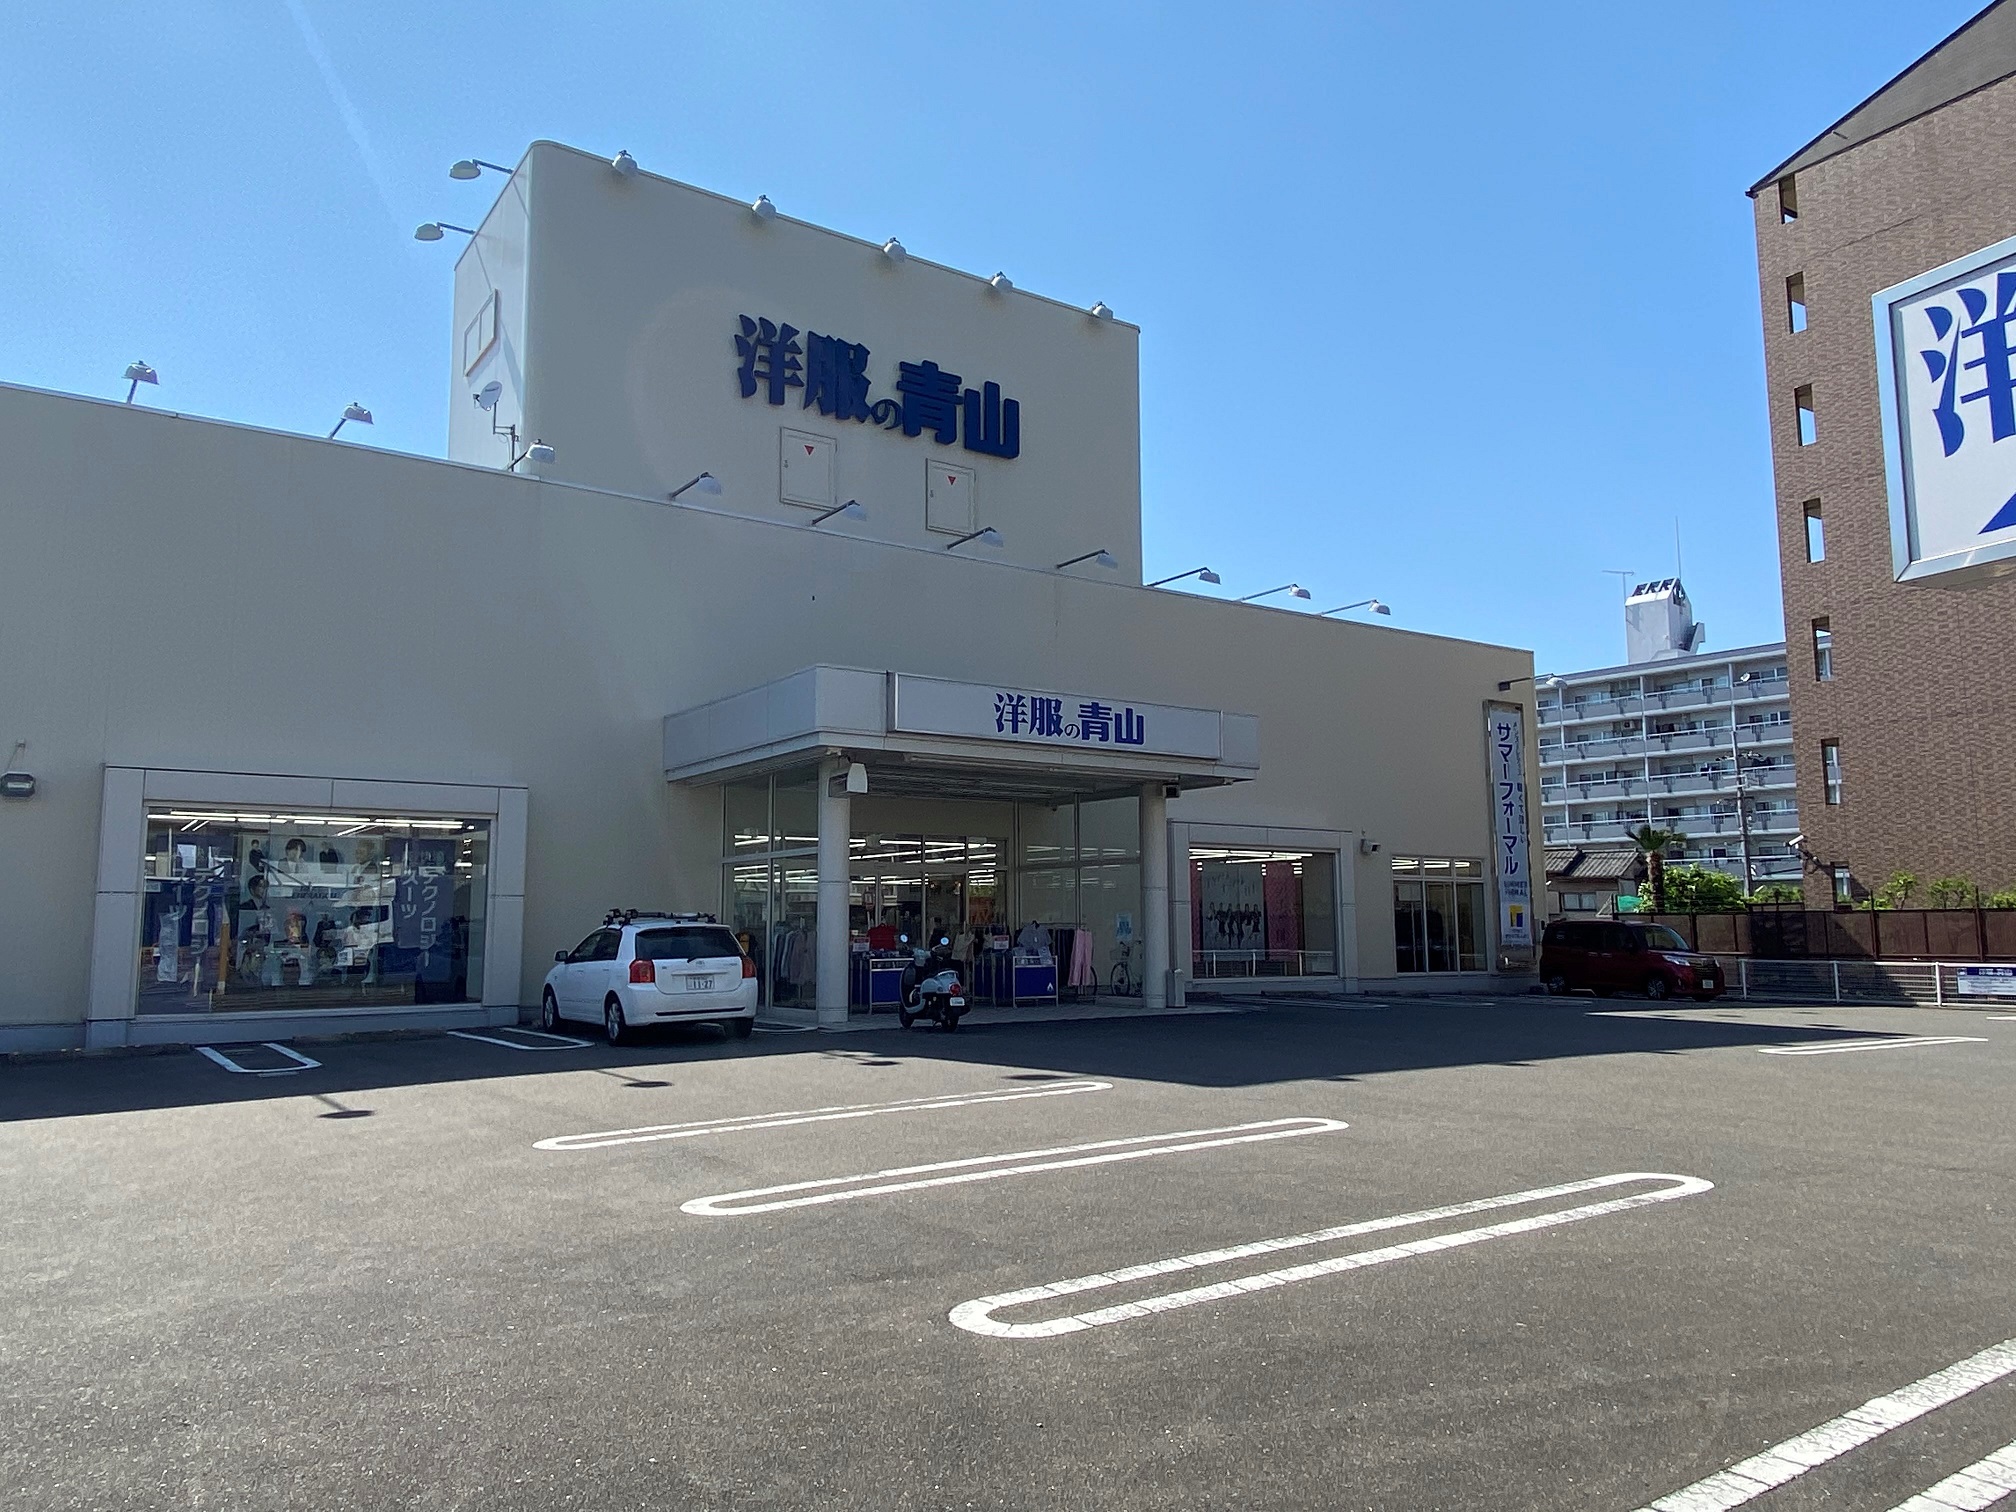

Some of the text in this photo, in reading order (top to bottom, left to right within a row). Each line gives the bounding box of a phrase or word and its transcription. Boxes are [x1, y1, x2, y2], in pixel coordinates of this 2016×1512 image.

[734, 314, 1021, 460] 洋服の青山
[993, 692, 1146, 746] 洋服の青山
[1496, 722, 1519, 876] サマーフォーマル
[420, 867, 441, 969] テクノロジー
